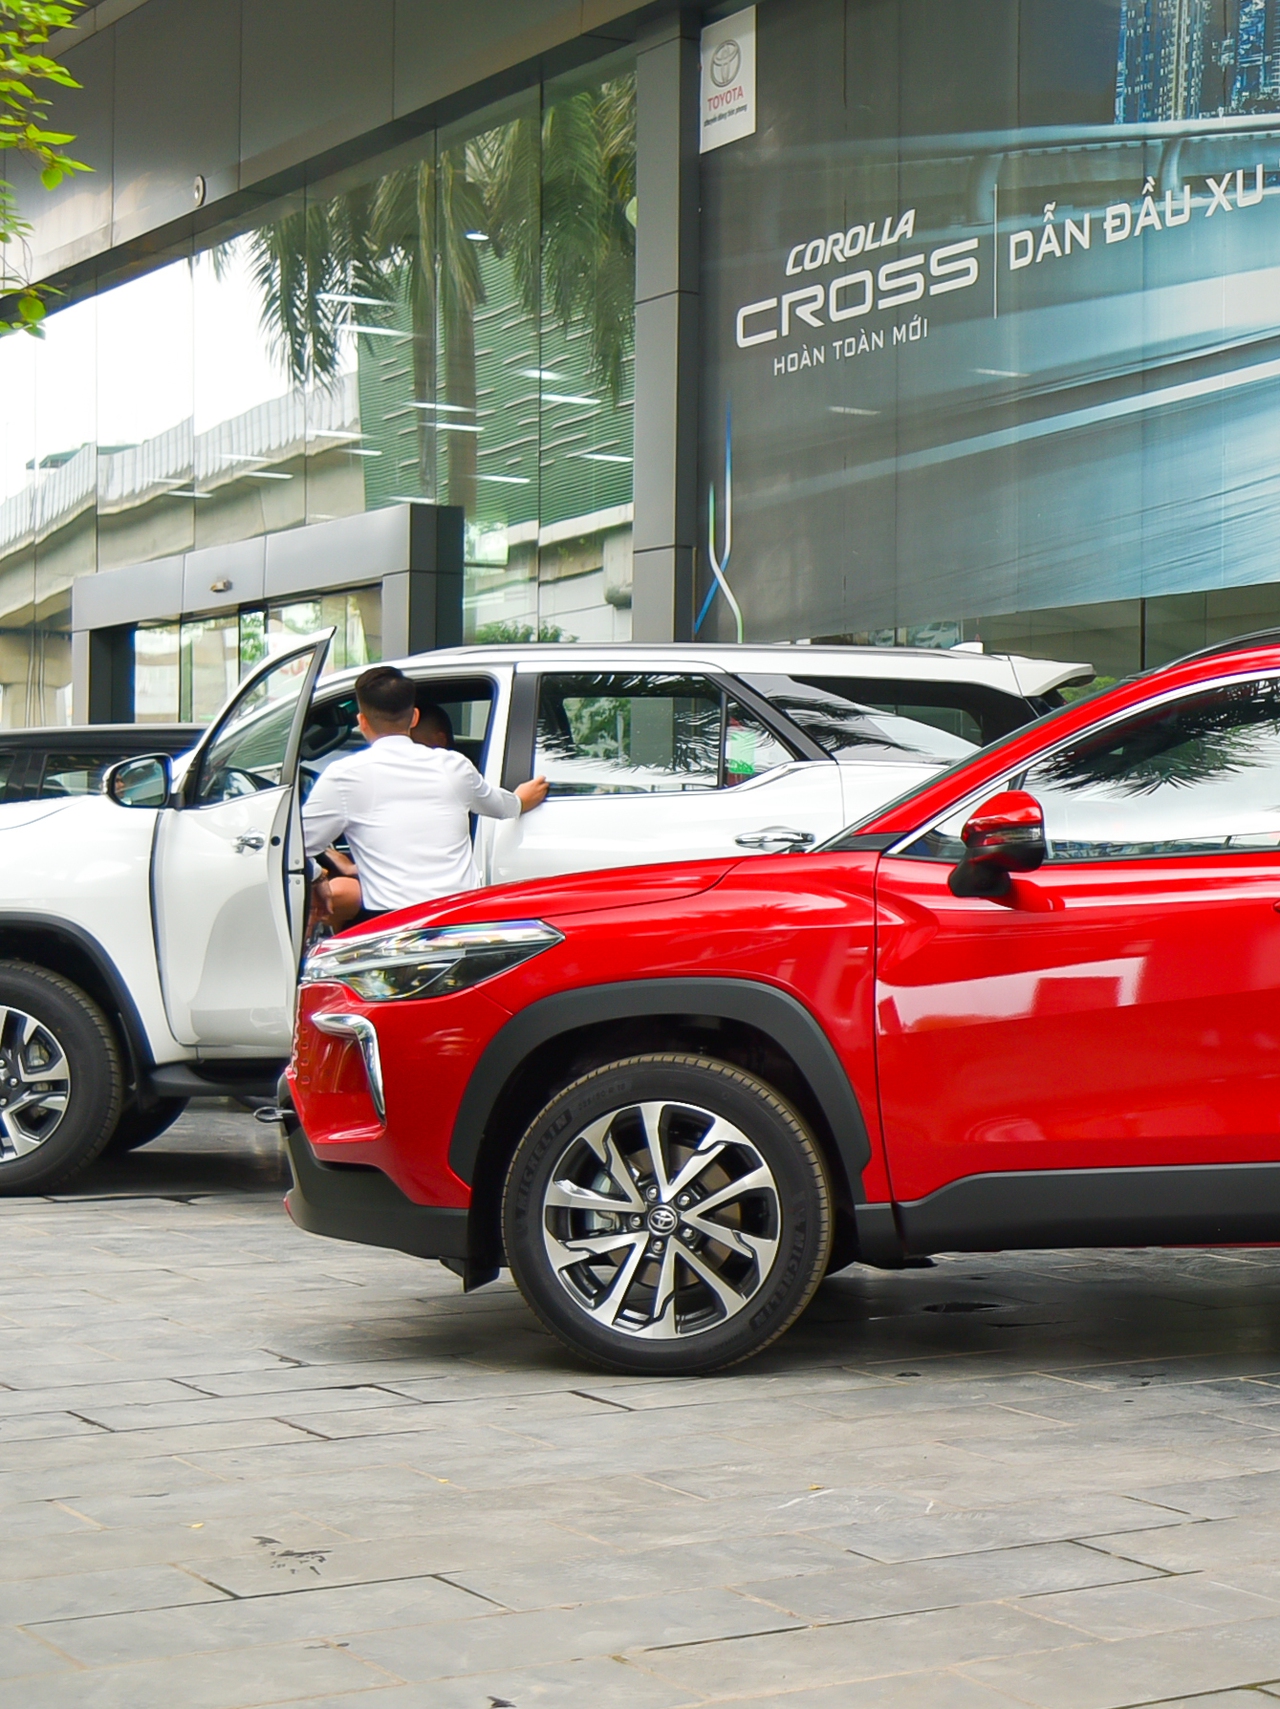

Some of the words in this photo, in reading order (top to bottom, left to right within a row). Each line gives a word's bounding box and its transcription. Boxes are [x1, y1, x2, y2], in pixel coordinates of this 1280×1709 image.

[707, 86, 744, 111] TOYOTA
[785, 208, 915, 276] COROLLA
[1009, 202, 1091, 271] DẪN
[1103, 176, 1190, 244] ĐẦU
[1205, 164, 1263, 217] XU
[736, 237, 979, 348] CROSS
[773, 344, 825, 376] HOÀN
[832, 328, 884, 360] TOÀN
[892, 314, 928, 347] MỚI
[517, 1113, 569, 1214] MICHELIN
[754, 1231, 806, 1328] MICHELIN
